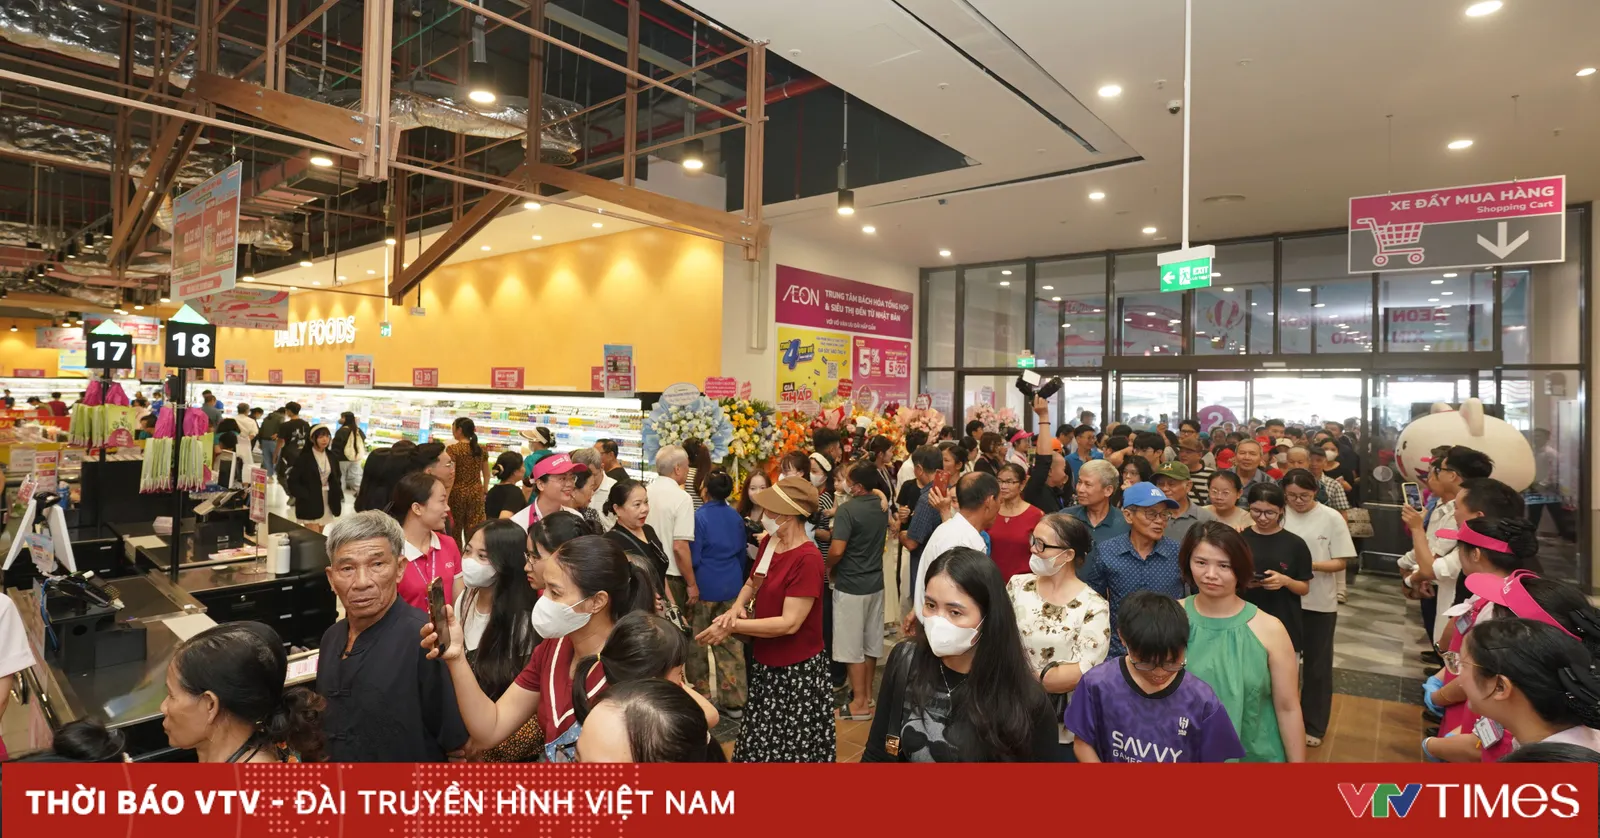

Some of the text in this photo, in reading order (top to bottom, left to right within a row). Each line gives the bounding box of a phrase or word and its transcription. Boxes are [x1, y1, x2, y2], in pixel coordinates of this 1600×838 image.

[1390, 185, 1555, 211] XE ĐẨY MUA HÀNG
[1476, 200, 1554, 213] Shopping Cart
[1192, 266, 1209, 275] EXIT
[825, 289, 845, 300] TRUNG
[845, 292, 858, 303] TÂM
[858, 295, 873, 305] BÁCH
[825, 302, 830, 311] &
[831, 302, 844, 312] SIÊU
[845, 306, 854, 316] THỊ
[876, 310, 889, 322] NHẬT
[274, 315, 356, 348] DAILY FOODS
[91, 341, 128, 361] 17
[172, 332, 211, 357] 18
[780, 384, 812, 403] THẤP
[1112, 730, 1183, 763] SAVVY
